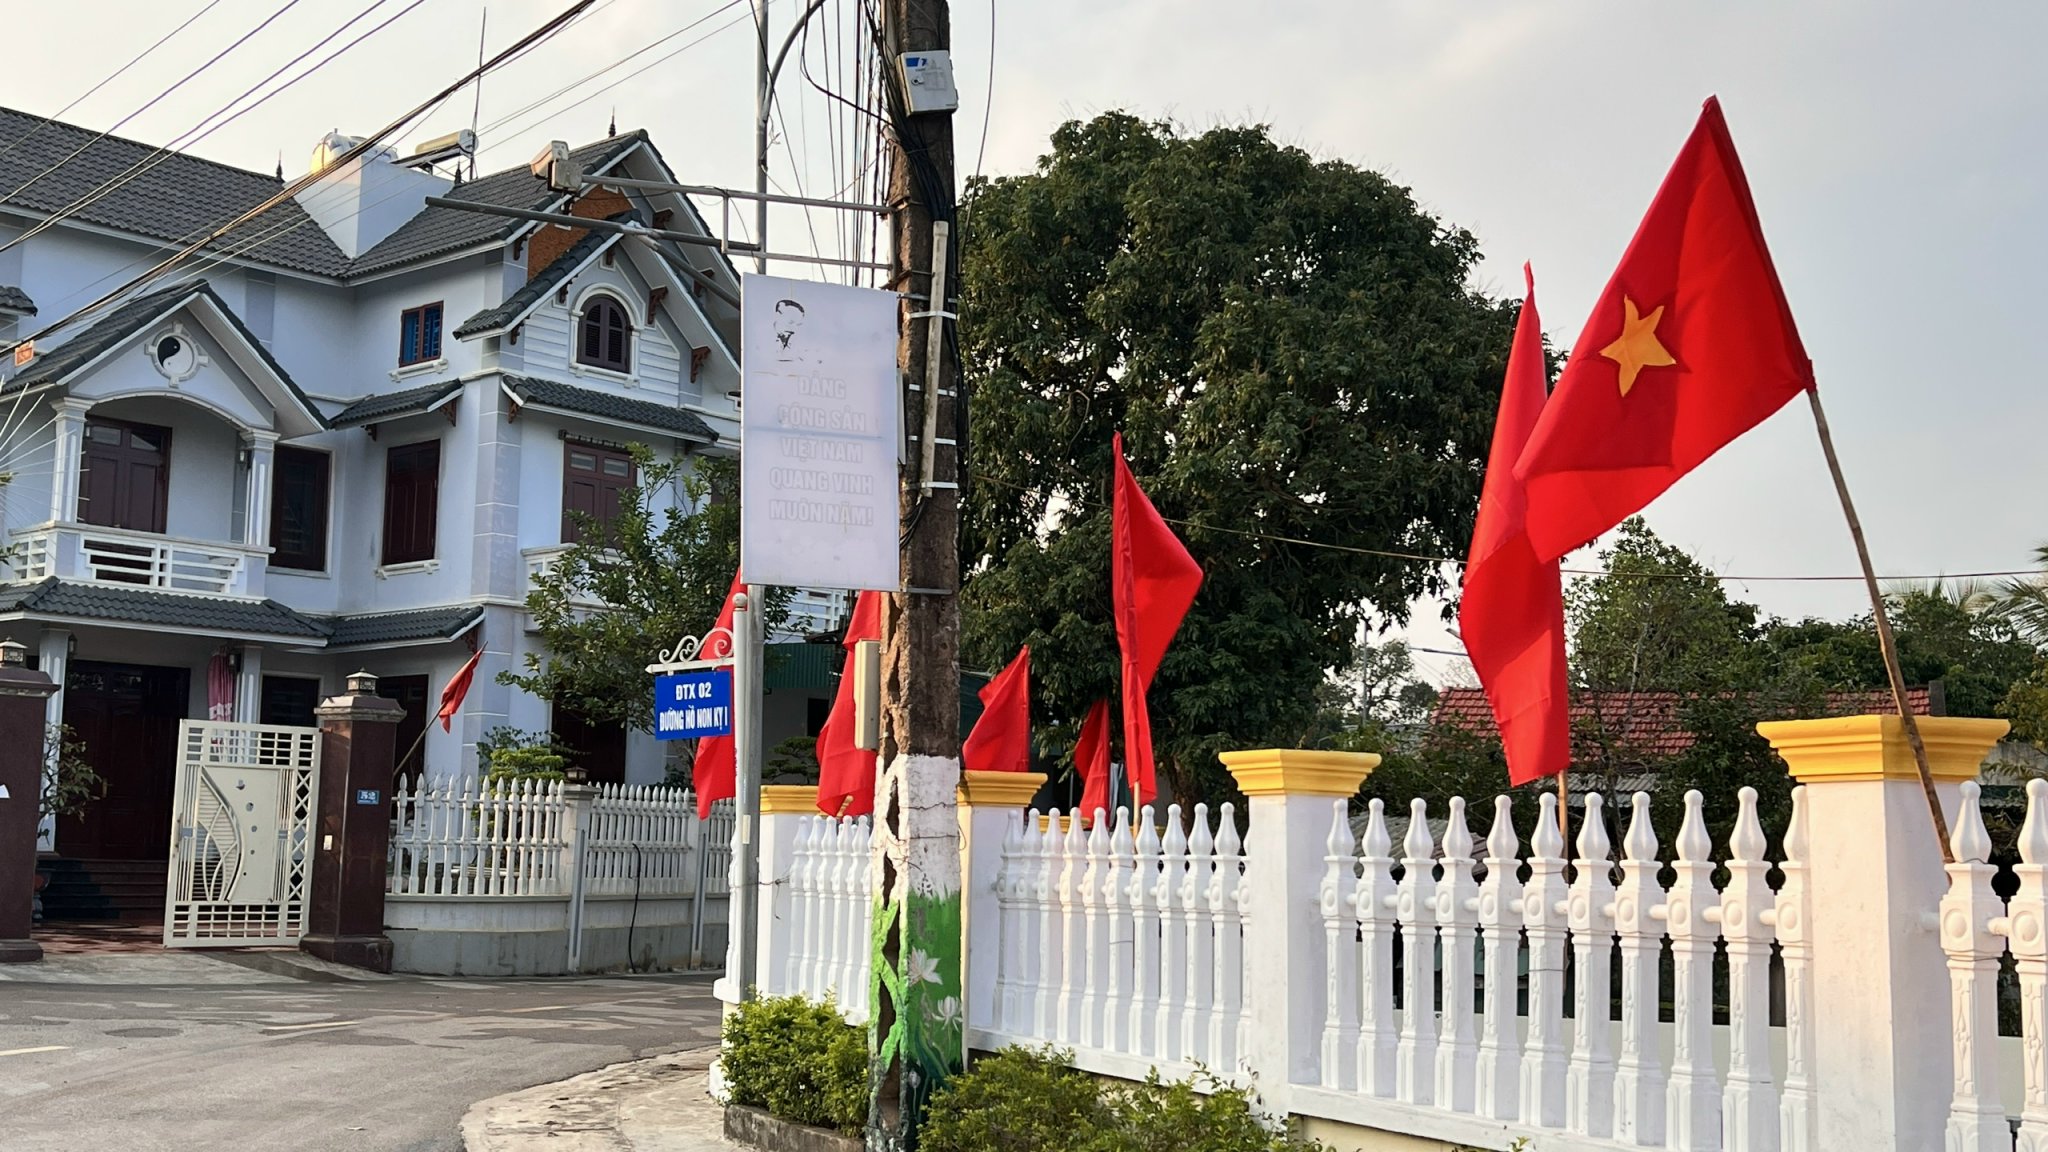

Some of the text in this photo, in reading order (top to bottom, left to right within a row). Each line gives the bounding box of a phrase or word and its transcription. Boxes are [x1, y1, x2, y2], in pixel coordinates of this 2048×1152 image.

[831, 405, 866, 432] SẢN
[822, 440, 863, 463] NAM
[769, 467, 874, 495] QUANG VINH
[769, 498, 874, 526] MUÔN NĂM!
[675, 682, 712, 700] ĐTX 02
[659, 707, 684, 731] ĐƯỜNG
[697, 707, 712, 729] NON
